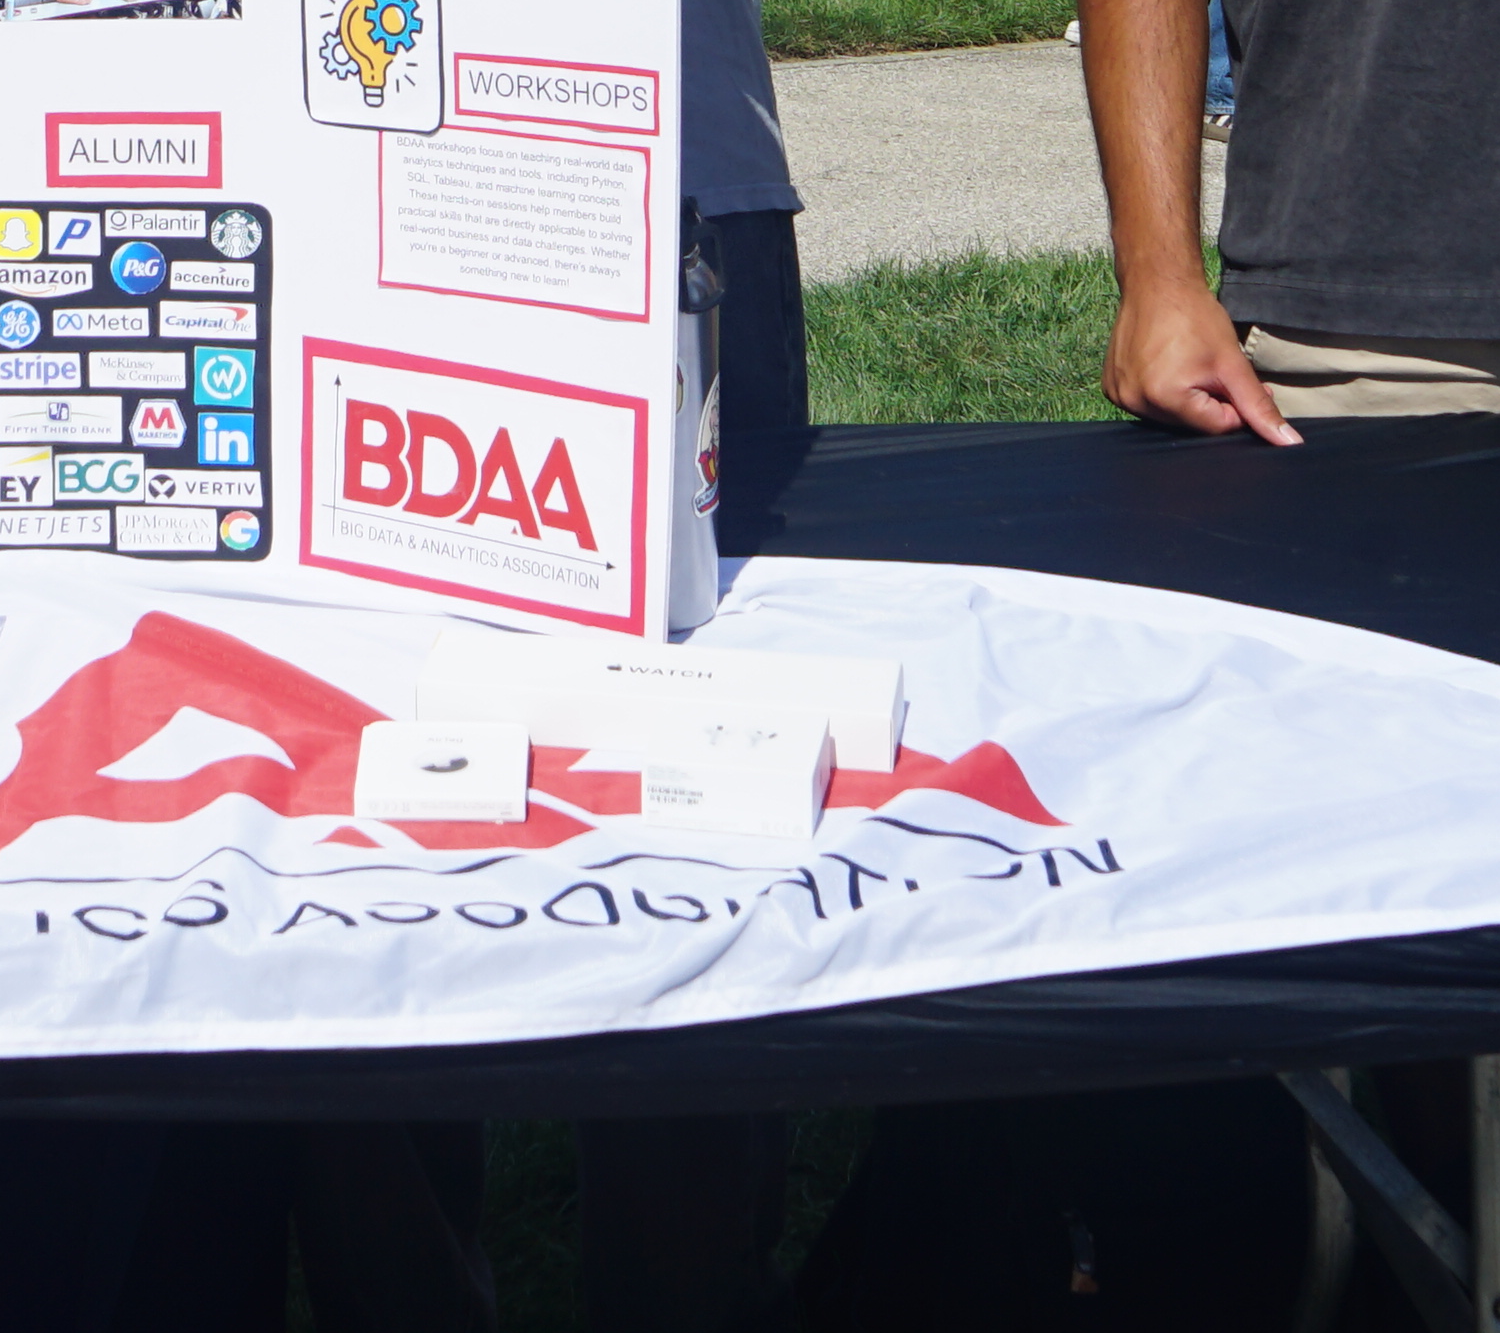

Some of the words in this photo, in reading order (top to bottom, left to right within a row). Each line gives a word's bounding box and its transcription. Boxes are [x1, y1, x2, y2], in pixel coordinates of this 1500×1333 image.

[468, 70, 648, 112] WORKSHOPS
[68, 137, 196, 165] ALUMNI
[397, 136, 426, 148] BDAA
[427, 142, 476, 155] workshops
[479, 145, 504, 158] focus
[506, 151, 518, 159] on
[521, 152, 561, 166] teaching
[564, 157, 610, 170] real-world
[613, 162, 633, 173] data
[132, 212, 200, 233] Palantir
[121, 257, 161, 279] P&G
[174, 272, 250, 289] accenture
[87, 312, 143, 332] Meta
[0, 355, 77, 386] stripe
[100, 357, 155, 370] McKinsey
[116, 370, 127, 382] &
[128, 369, 184, 385] Company
[141, 406, 174, 430] M
[137, 430, 180, 440] MARATHON
[59, 459, 140, 495] BCG
[343, 397, 599, 552] BDAA
[1, 476, 41, 503] EY
[185, 481, 256, 497] VERTIV
[340, 520, 364, 537] BIG
[368, 524, 404, 548] DATA
[407, 534, 418, 549] &
[420, 536, 499, 568] ANALYTICS
[502, 551, 600, 590] ASSOCIATION
[629, 665, 713, 680] WATCH
